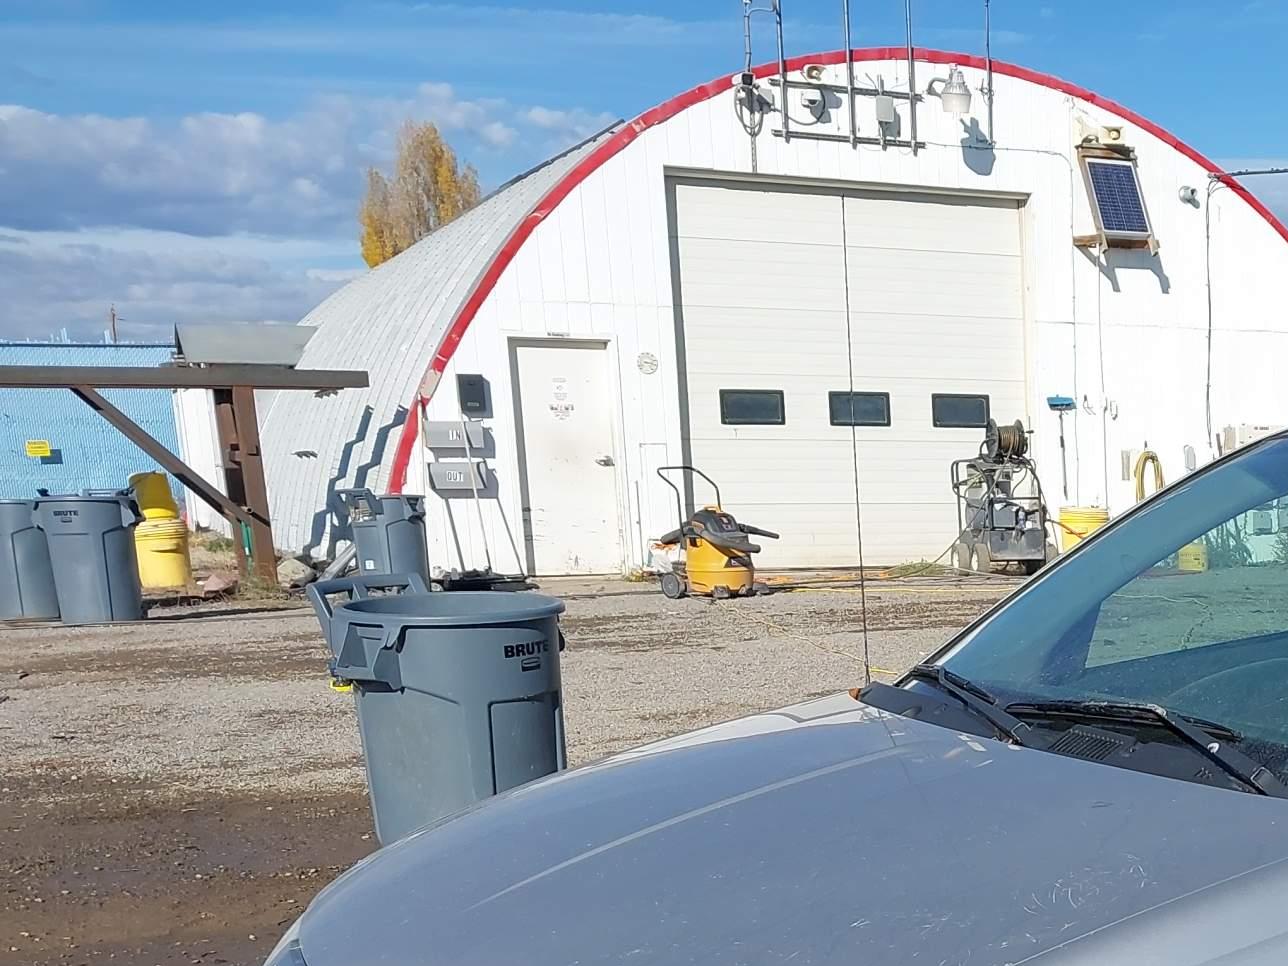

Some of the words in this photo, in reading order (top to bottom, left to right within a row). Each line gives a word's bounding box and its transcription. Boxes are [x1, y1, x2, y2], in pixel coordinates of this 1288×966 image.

[449, 430, 462, 441] IN
[447, 471, 464, 481] OUT
[504, 640, 549, 658] BRUTE
